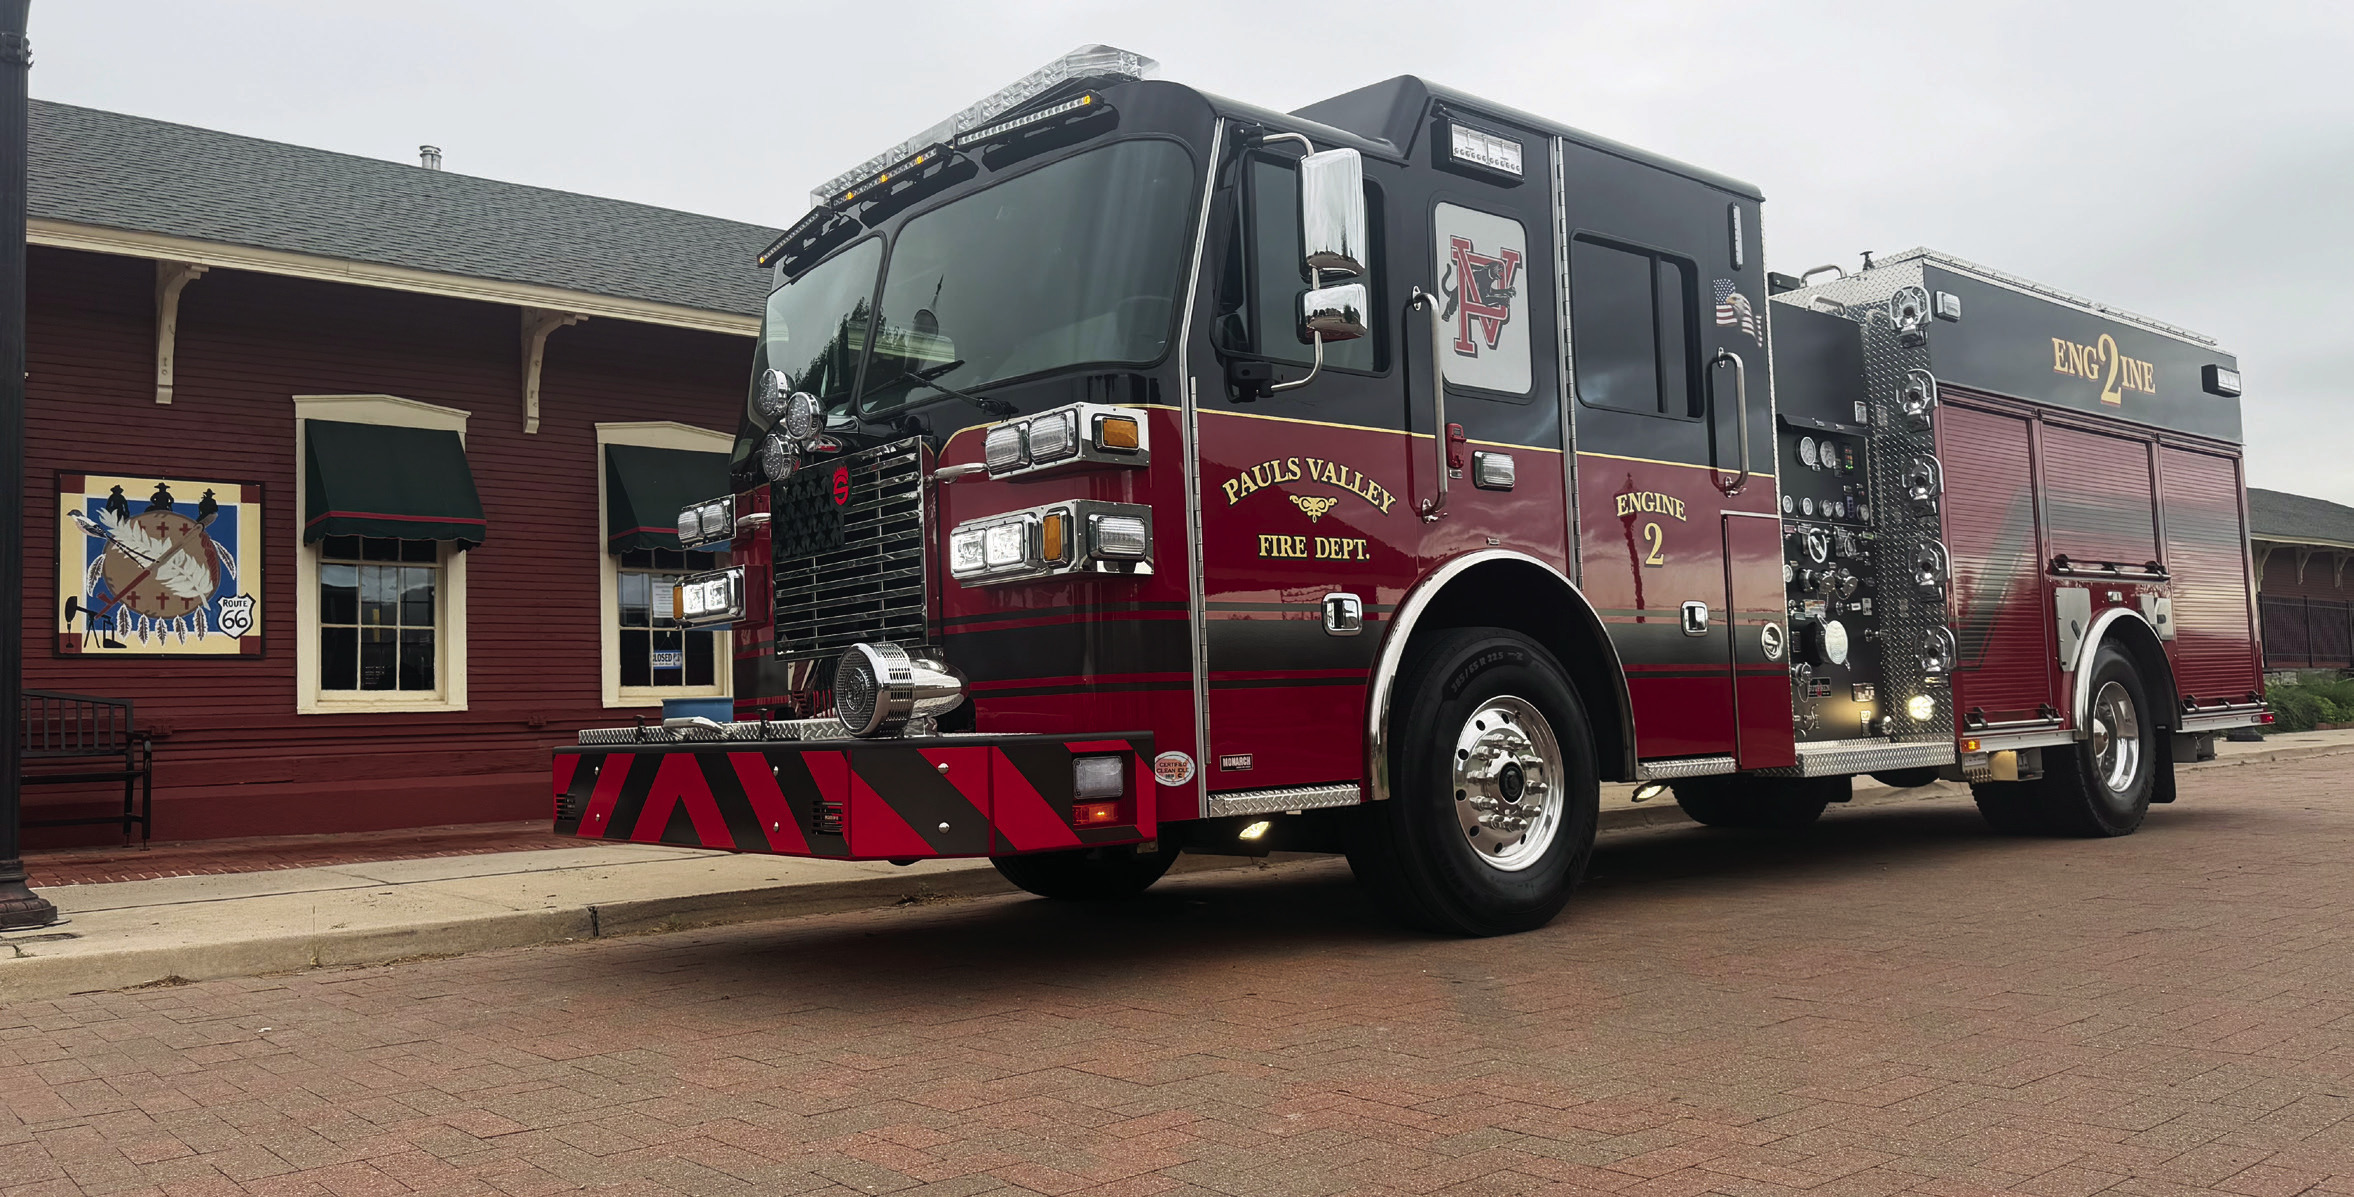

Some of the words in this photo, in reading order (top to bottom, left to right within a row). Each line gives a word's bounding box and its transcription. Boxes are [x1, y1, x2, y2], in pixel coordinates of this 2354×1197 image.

[1222, 457, 1301, 505] PAULS
[1305, 457, 1397, 514] VALLEY
[1616, 491, 1687, 522] ENGINE
[1258, 534, 1308, 559] FIRE
[1314, 536, 1371, 561] DEPT.
[1644, 522, 1664, 567] 2
[222, 599, 248, 607] ROUTE
[222, 610, 248, 629] 66
[1222, 756, 1251, 767] MONARCH
